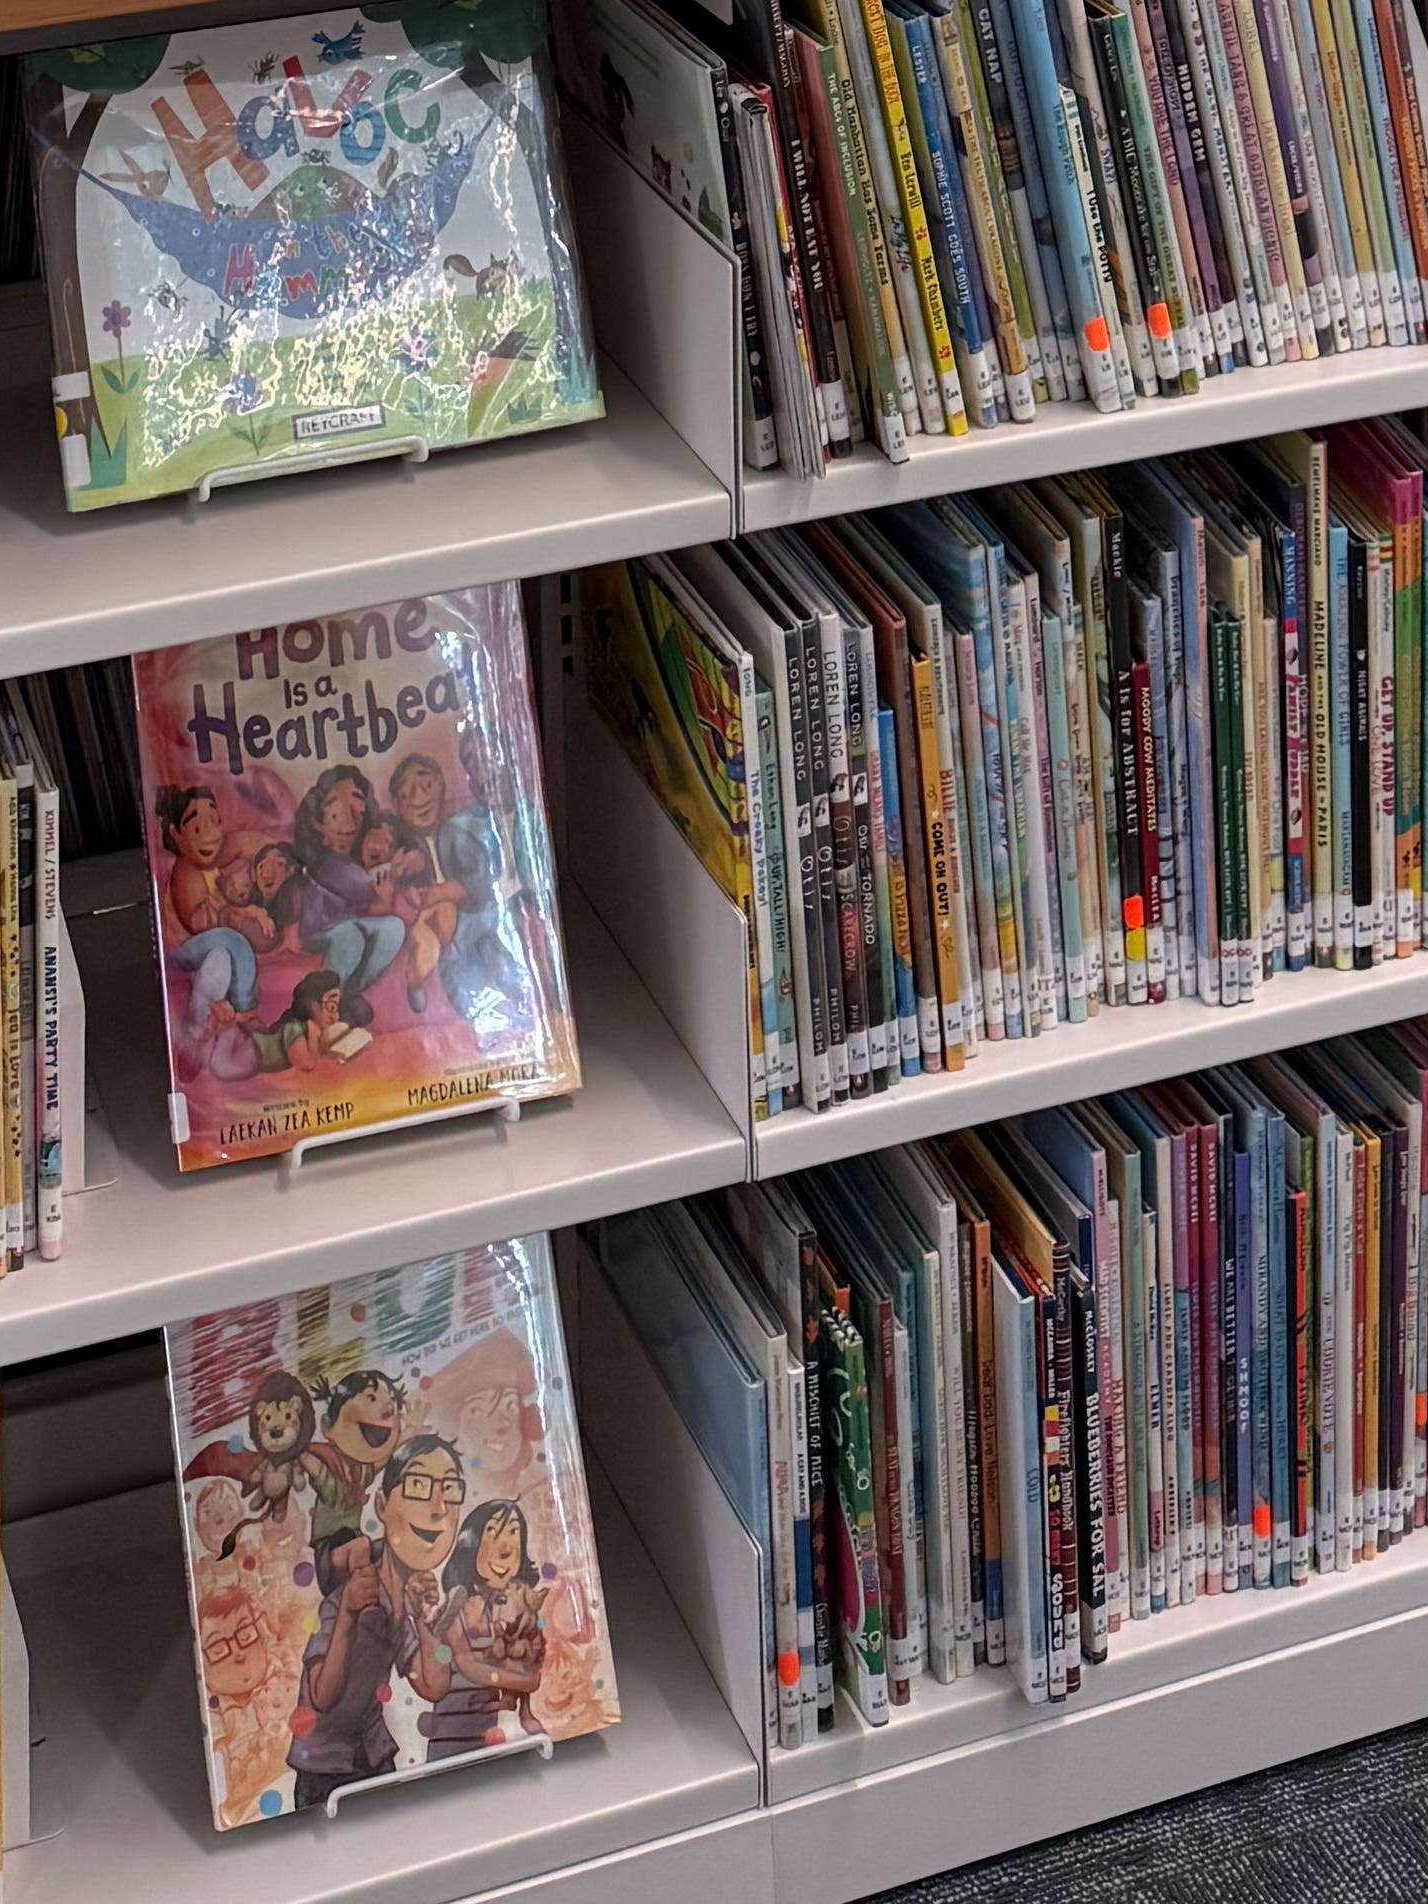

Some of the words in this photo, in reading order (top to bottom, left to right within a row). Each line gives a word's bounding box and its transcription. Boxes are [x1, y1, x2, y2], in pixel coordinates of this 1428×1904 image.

[978, 7, 994, 42] CAT
[983, 43, 1003, 85] NAP
[1178, 63, 1196, 118] HIDDEN
[1188, 121, 1207, 163] GEM
[235, 596, 438, 681] Home
[1313, 599, 1326, 671] MADELINE
[284, 678, 308, 709] Is
[315, 674, 338, 697] a
[788, 657, 802, 722] LOREN
[806, 645, 820, 709] LOREN
[823, 648, 839, 704] LOREN
[845, 642, 859, 692] LOREN
[187, 669, 460, 775] Heartbea
[828, 707, 844, 760] LONG
[848, 694, 863, 749] LONG
[1139, 686, 1152, 732] MOODY
[792, 726, 807, 782] LONG
[809, 714, 824, 773] LONG
[1142, 733, 1154, 762] COW
[1121, 743, 1139, 837] ABSTRACT
[1144, 763, 1158, 833] MEDITATES
[44, 808, 56, 853] KIMMEL
[1317, 806, 1329, 849] PARIS
[44, 860, 56, 922] STEVENS
[42, 945, 58, 1011] ANANSI'S
[42, 1015, 59, 1068] PARTY
[45, 1069, 60, 1113] TIME
[406, 1070, 497, 1106] MAGDALENA
[219, 1116, 278, 1144] LAEKAN
[282, 1108, 312, 1133] ZEA
[315, 1100, 355, 1127] KEMP
[1083, 1391, 1103, 1513] BLUEBERRIES
[1091, 1518, 1107, 1557] FOR
[1091, 1559, 1108, 1599] SAL
